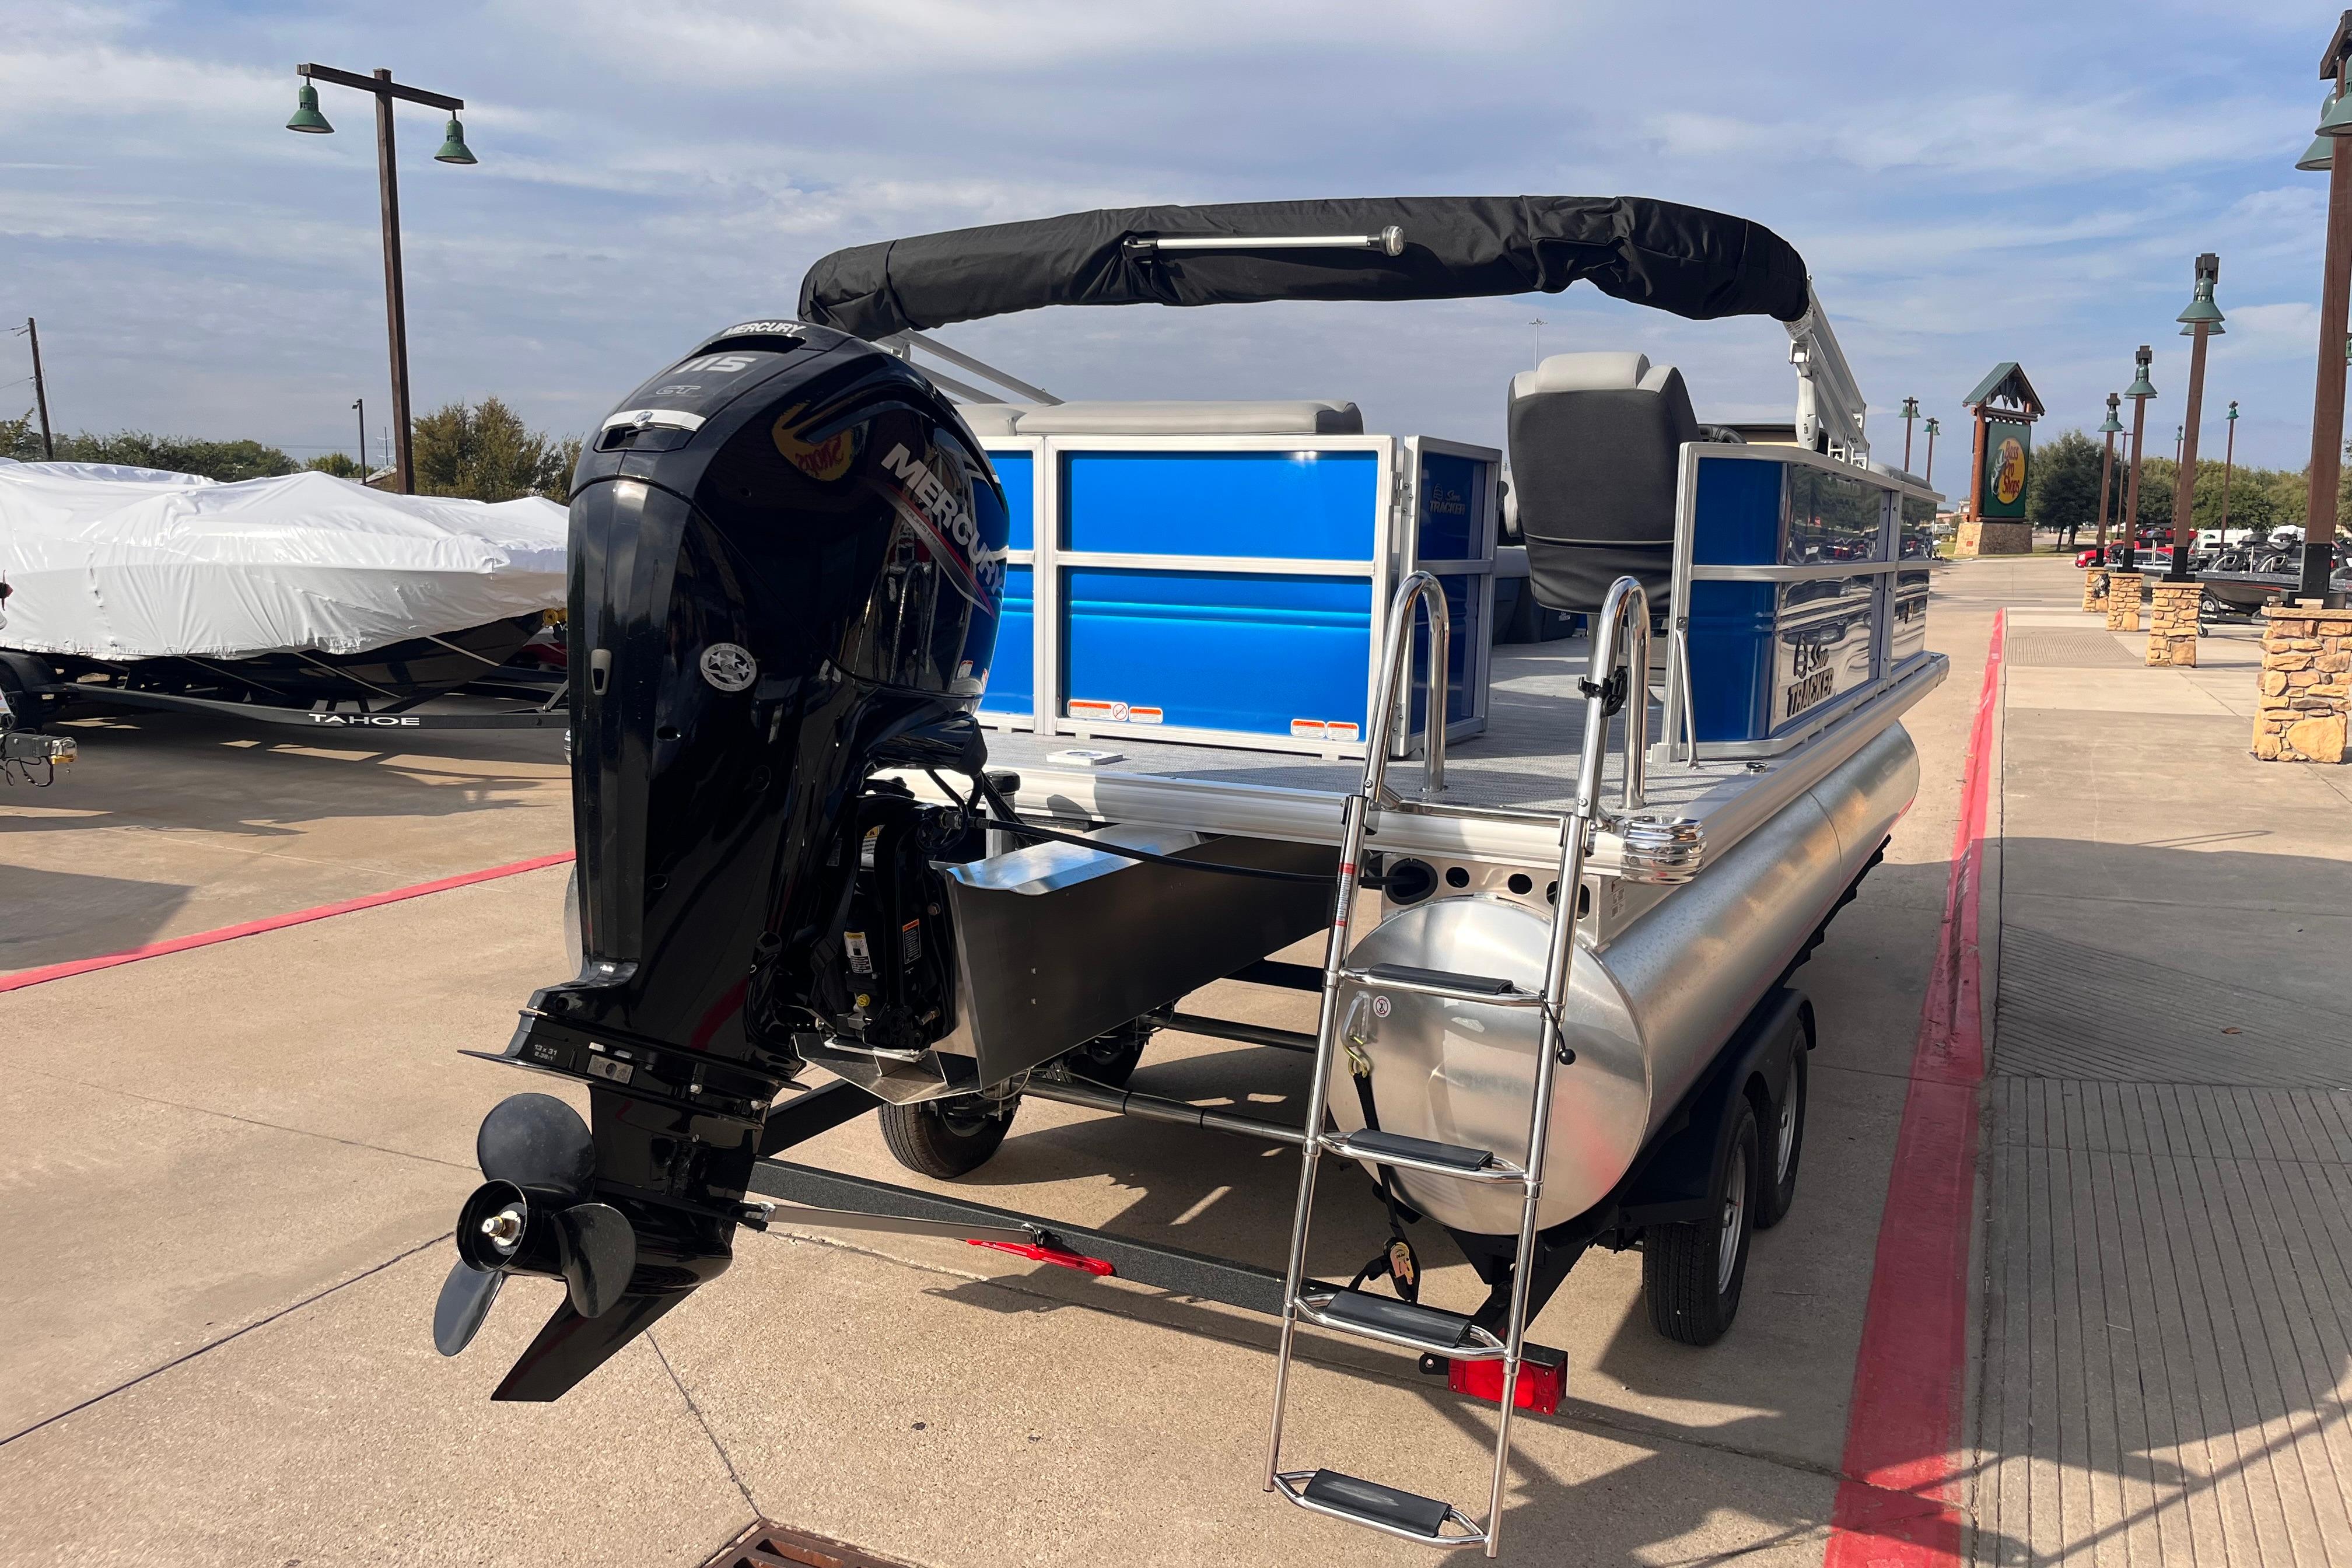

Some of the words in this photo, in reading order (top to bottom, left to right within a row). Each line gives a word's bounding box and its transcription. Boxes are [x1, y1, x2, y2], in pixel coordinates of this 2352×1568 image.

[720, 322, 807, 337] MERCURY
[674, 357, 757, 372] 115
[2005, 440, 2019, 461] Bass
[2003, 459, 2015, 477] Pro
[2002, 475, 2020, 499] Shops
[881, 443, 1003, 595] MERCURY
[1808, 639, 1829, 671] Sun
[1787, 667, 1834, 718] TRACKER
[309, 713, 420, 726] TAHOE
